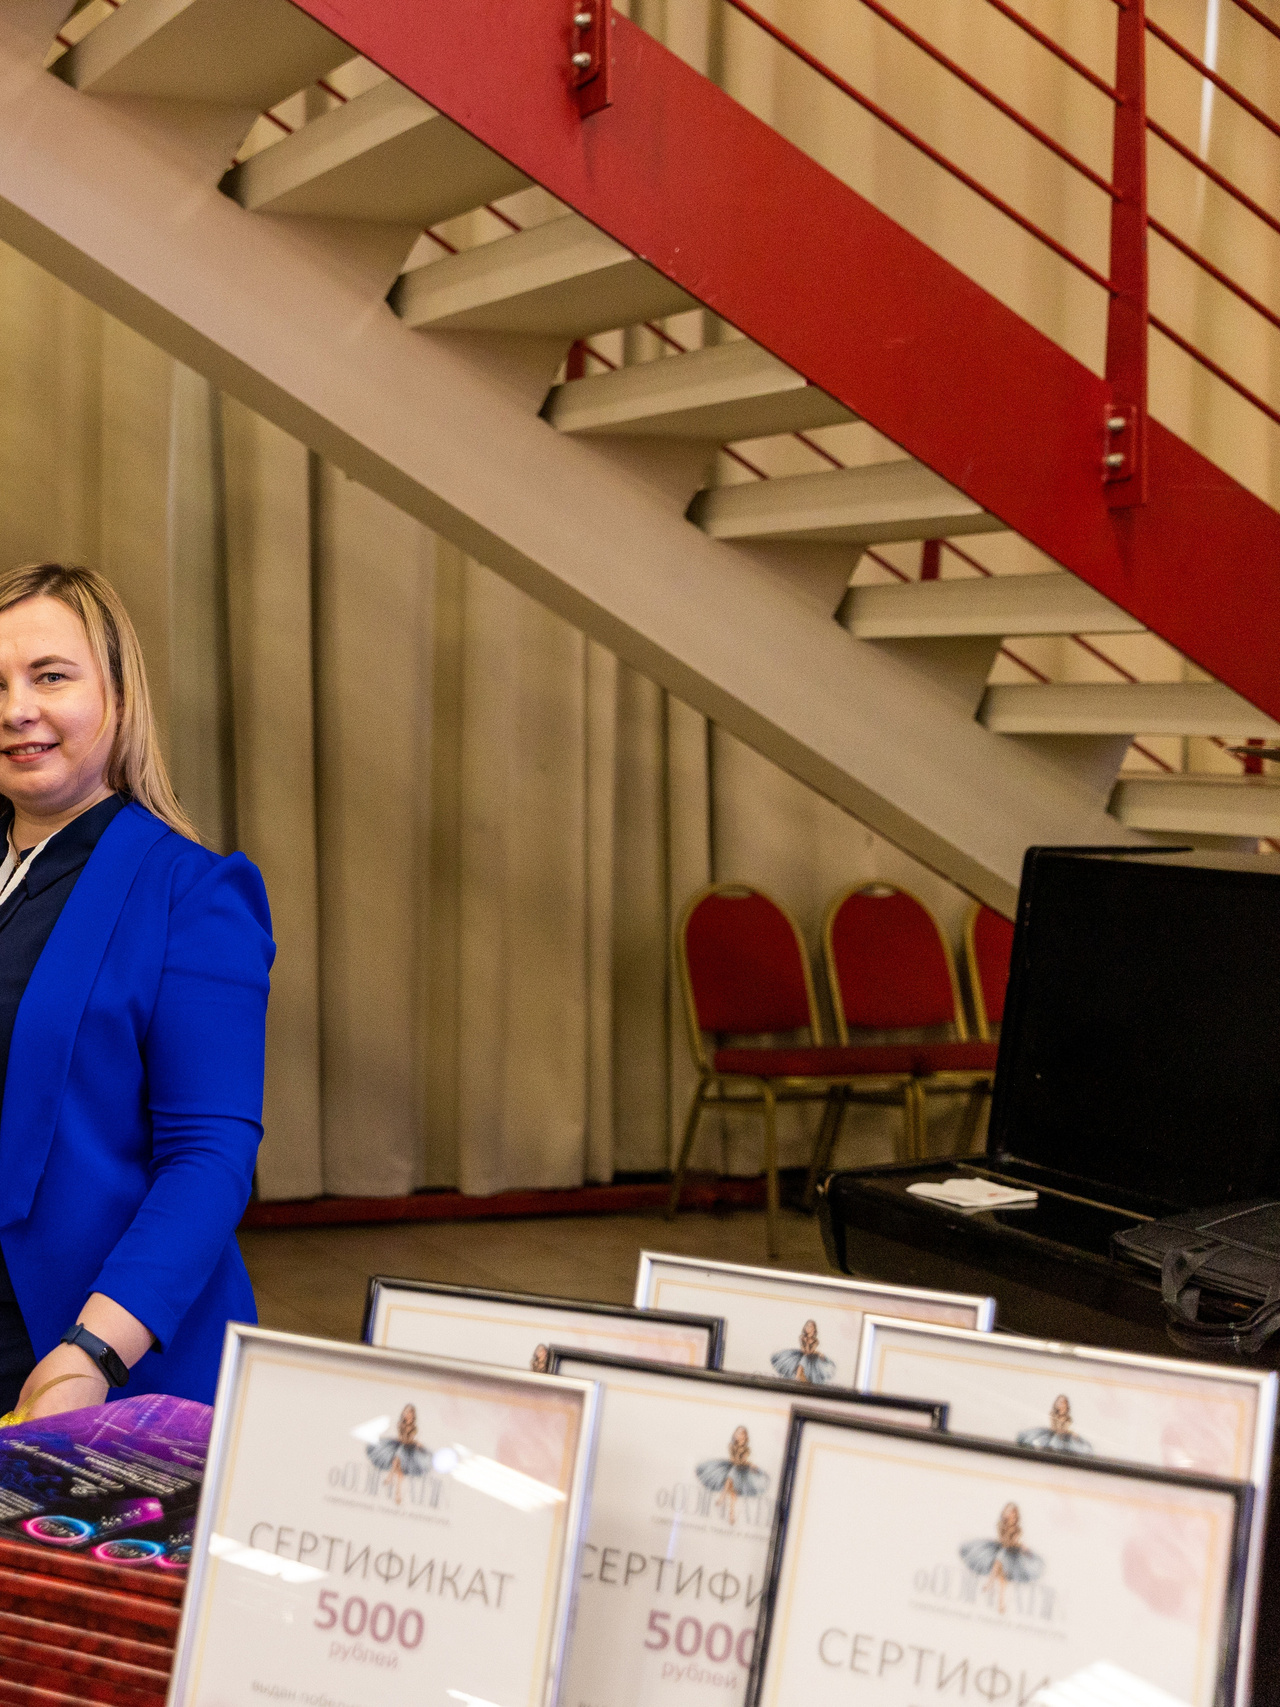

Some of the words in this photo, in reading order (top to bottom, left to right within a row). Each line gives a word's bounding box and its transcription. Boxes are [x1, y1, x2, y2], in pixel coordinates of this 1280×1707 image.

[249, 1521, 515, 1609] СЕРТИФИКАТ
[314, 1588, 425, 1650] 5000
[329, 1639, 399, 1671] рублей
[661, 1661, 739, 1691] рублей
